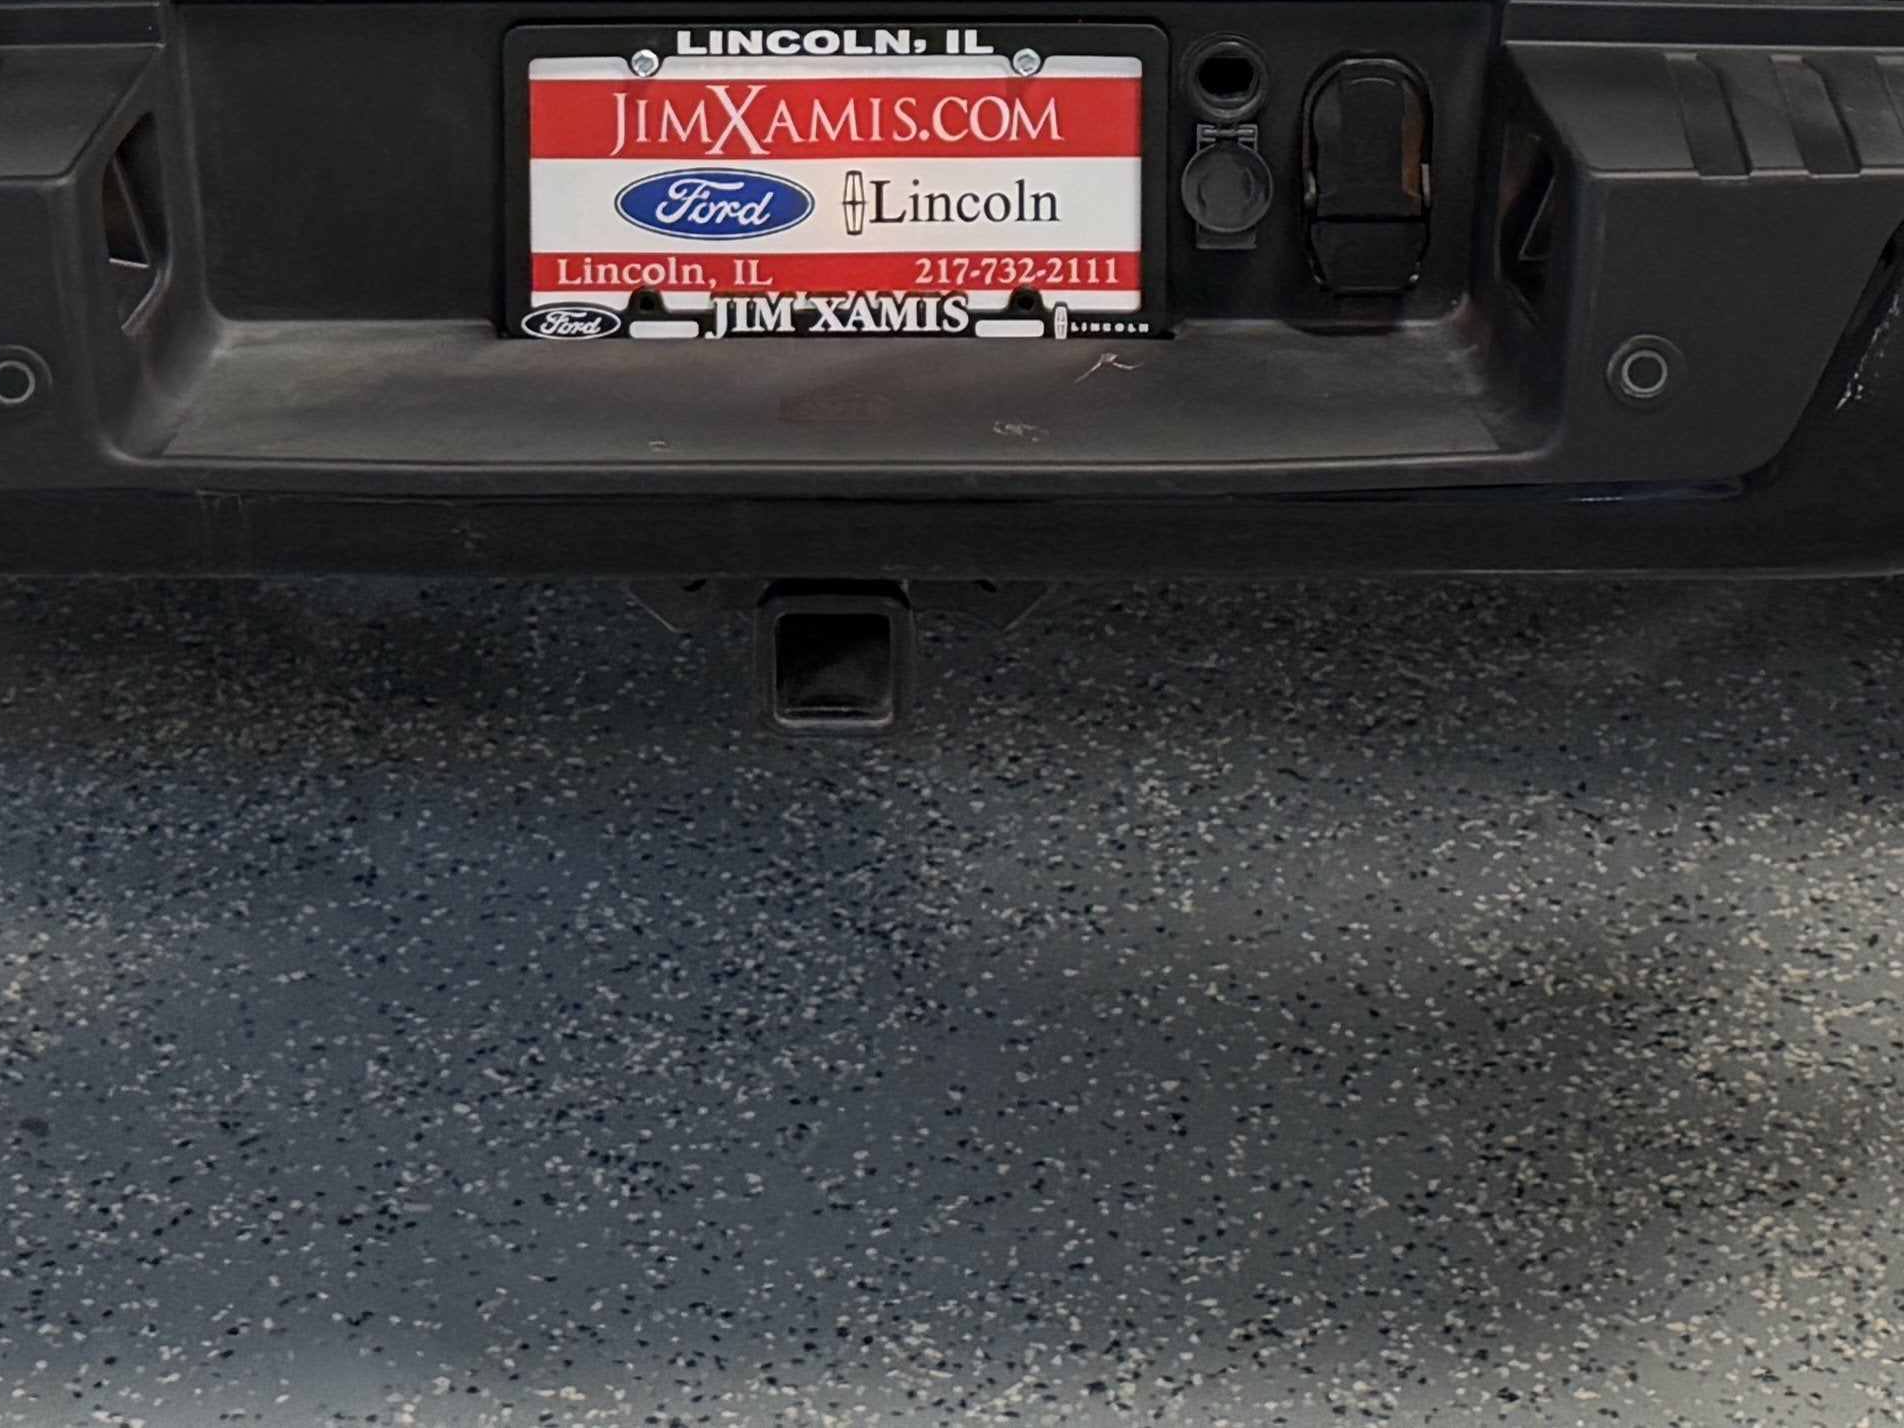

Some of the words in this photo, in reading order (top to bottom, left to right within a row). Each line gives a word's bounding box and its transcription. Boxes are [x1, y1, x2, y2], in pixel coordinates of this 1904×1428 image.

[676, 29, 927, 56] LINCOLN,
[945, 29, 994, 55] IL
[655, 177, 772, 227] Ford
[869, 179, 1061, 224] Lincoln
[557, 256, 717, 289] Lincoln,
[733, 258, 773, 287] IL
[914, 257, 1119, 287] 217-732-2111
[539, 307, 601, 334] Ford
[705, 296, 796, 339] JIM
[809, 296, 969, 333] XAMIS
